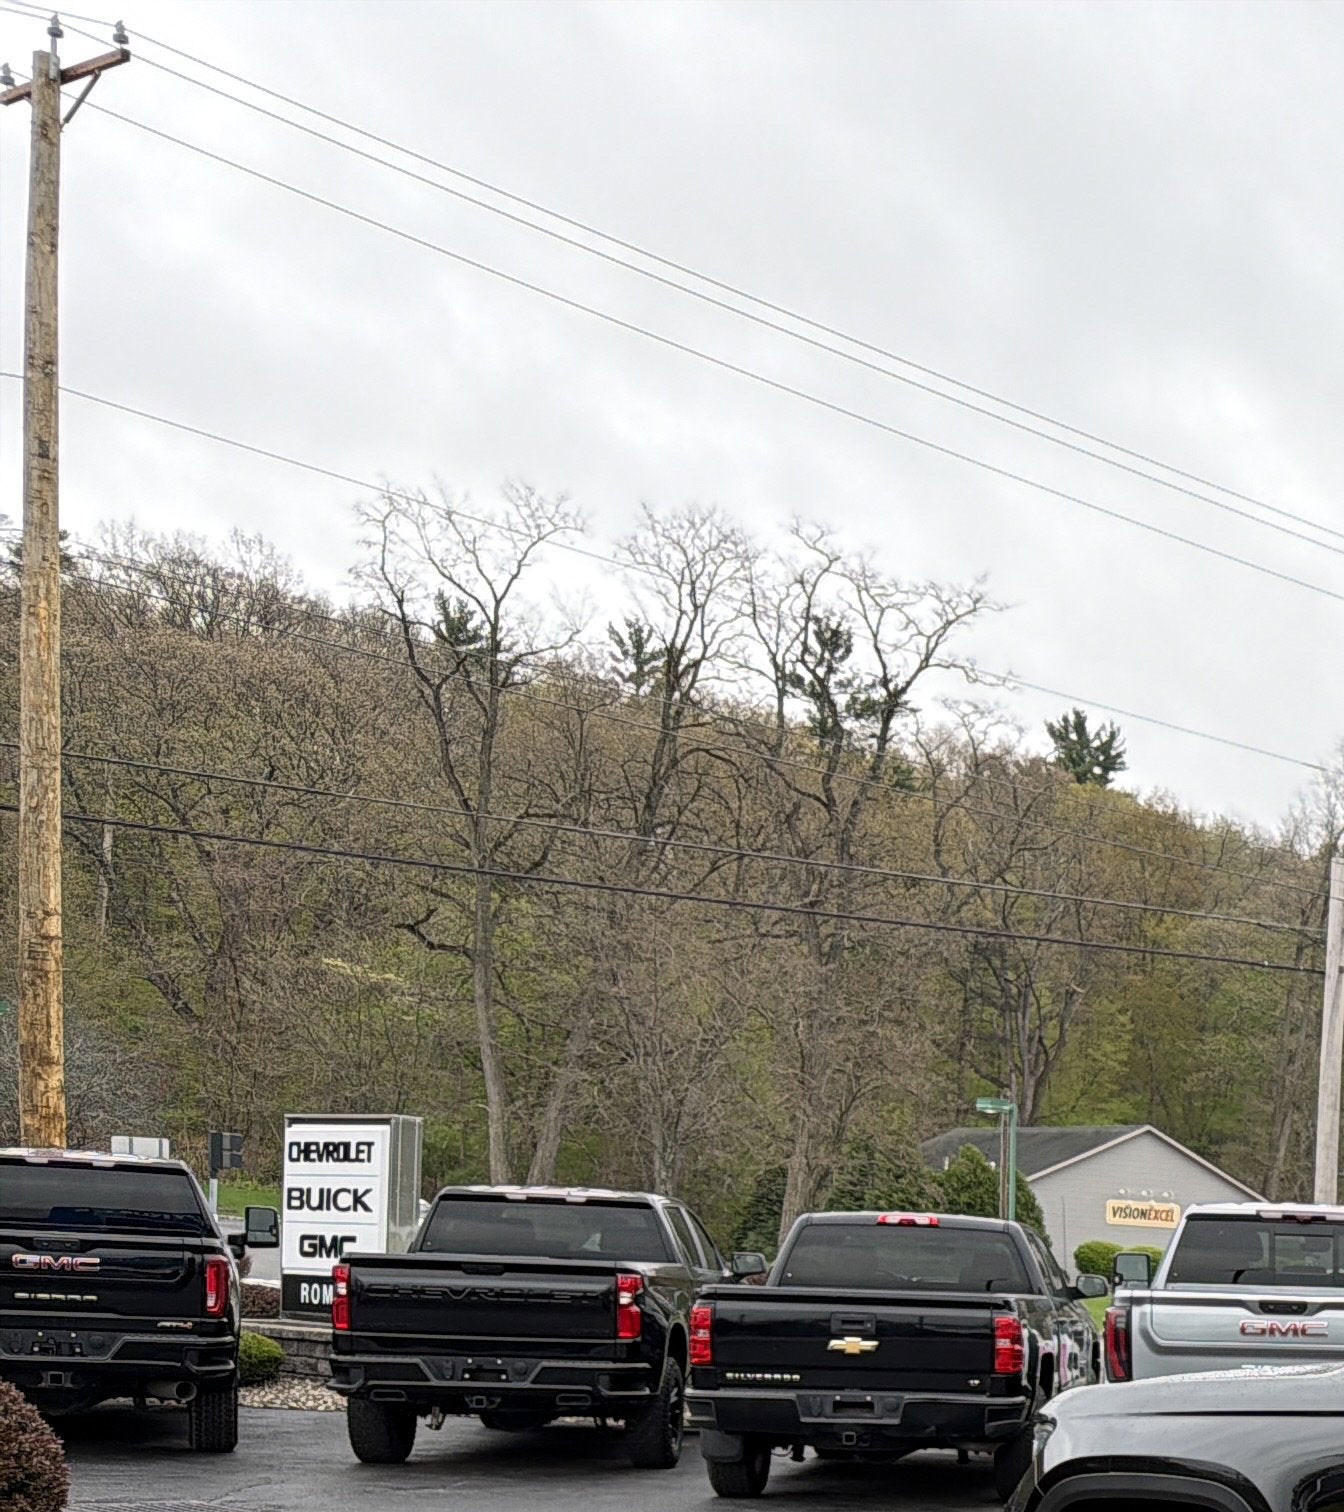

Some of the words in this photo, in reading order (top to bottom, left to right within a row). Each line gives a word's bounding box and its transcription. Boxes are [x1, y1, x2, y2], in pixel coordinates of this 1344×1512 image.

[288, 1141, 375, 1163] CHEVROLET
[287, 1187, 373, 1212] BUICK
[299, 1234, 357, 1258] GMC
[12, 1254, 100, 1272] GMC
[1240, 1320, 1328, 1338] GMC
[725, 1372, 800, 1382] SILVERADO
